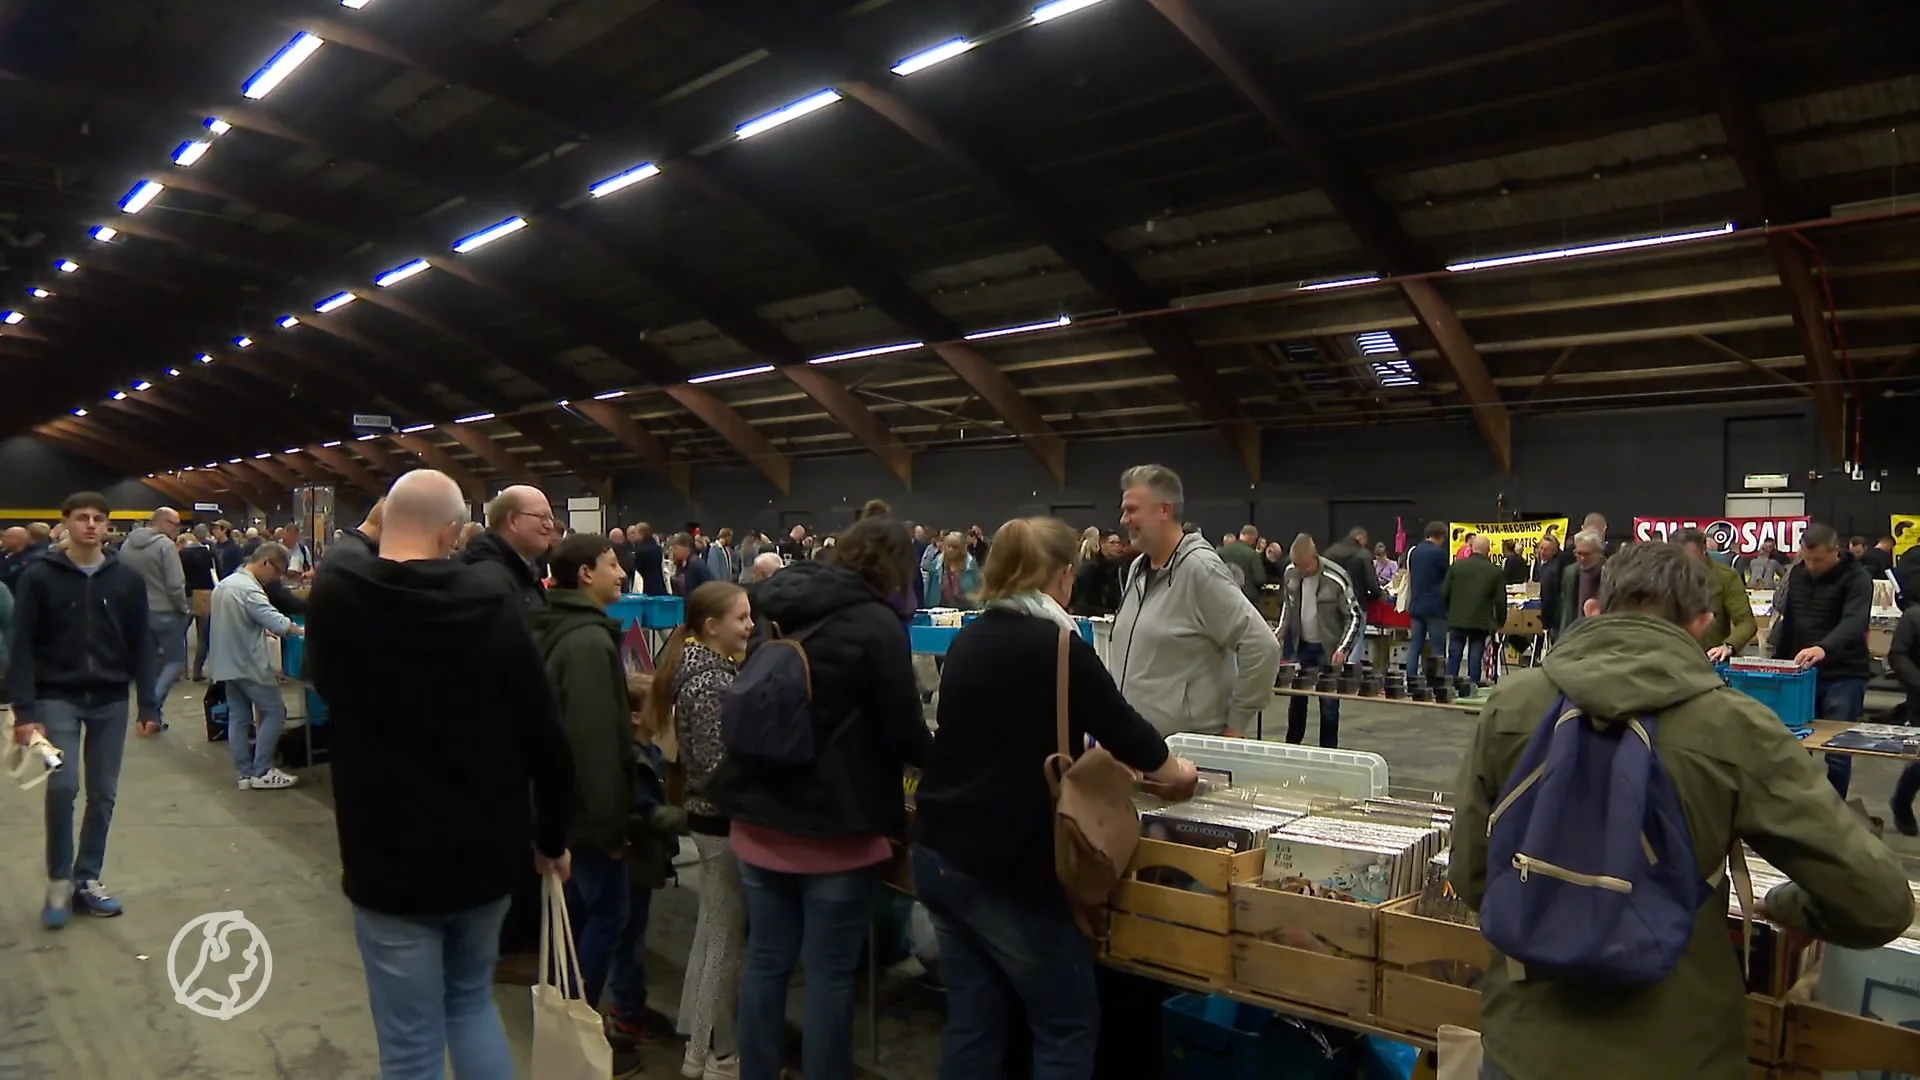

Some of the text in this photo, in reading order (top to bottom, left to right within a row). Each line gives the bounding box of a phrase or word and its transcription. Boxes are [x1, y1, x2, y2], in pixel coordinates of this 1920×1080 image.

[1636, 521, 1697, 542] SA
[1740, 520, 1807, 553] SALE
[1432, 791, 1443, 803] M
